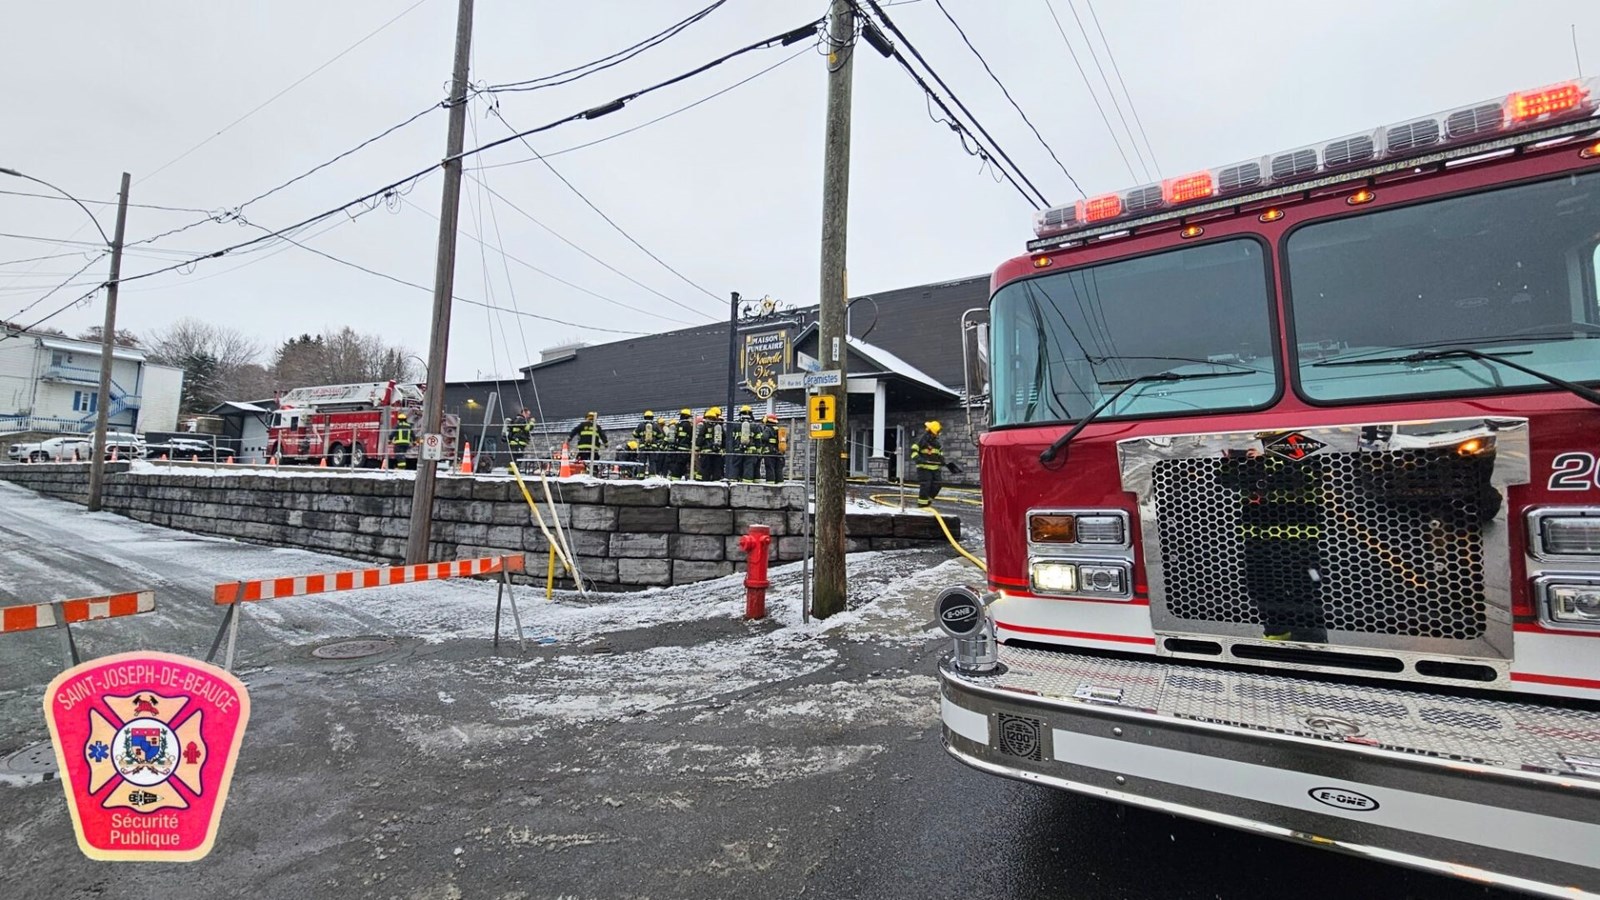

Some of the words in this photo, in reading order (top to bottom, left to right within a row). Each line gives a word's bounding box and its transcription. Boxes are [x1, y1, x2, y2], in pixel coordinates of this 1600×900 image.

[753, 335, 779, 345] MAISON
[804, 374, 838, 386] Céramistes
[1547, 451, 1600, 491] 2
[946, 607, 970, 619] E-ONE
[1320, 791, 1367, 807] E-ONE
